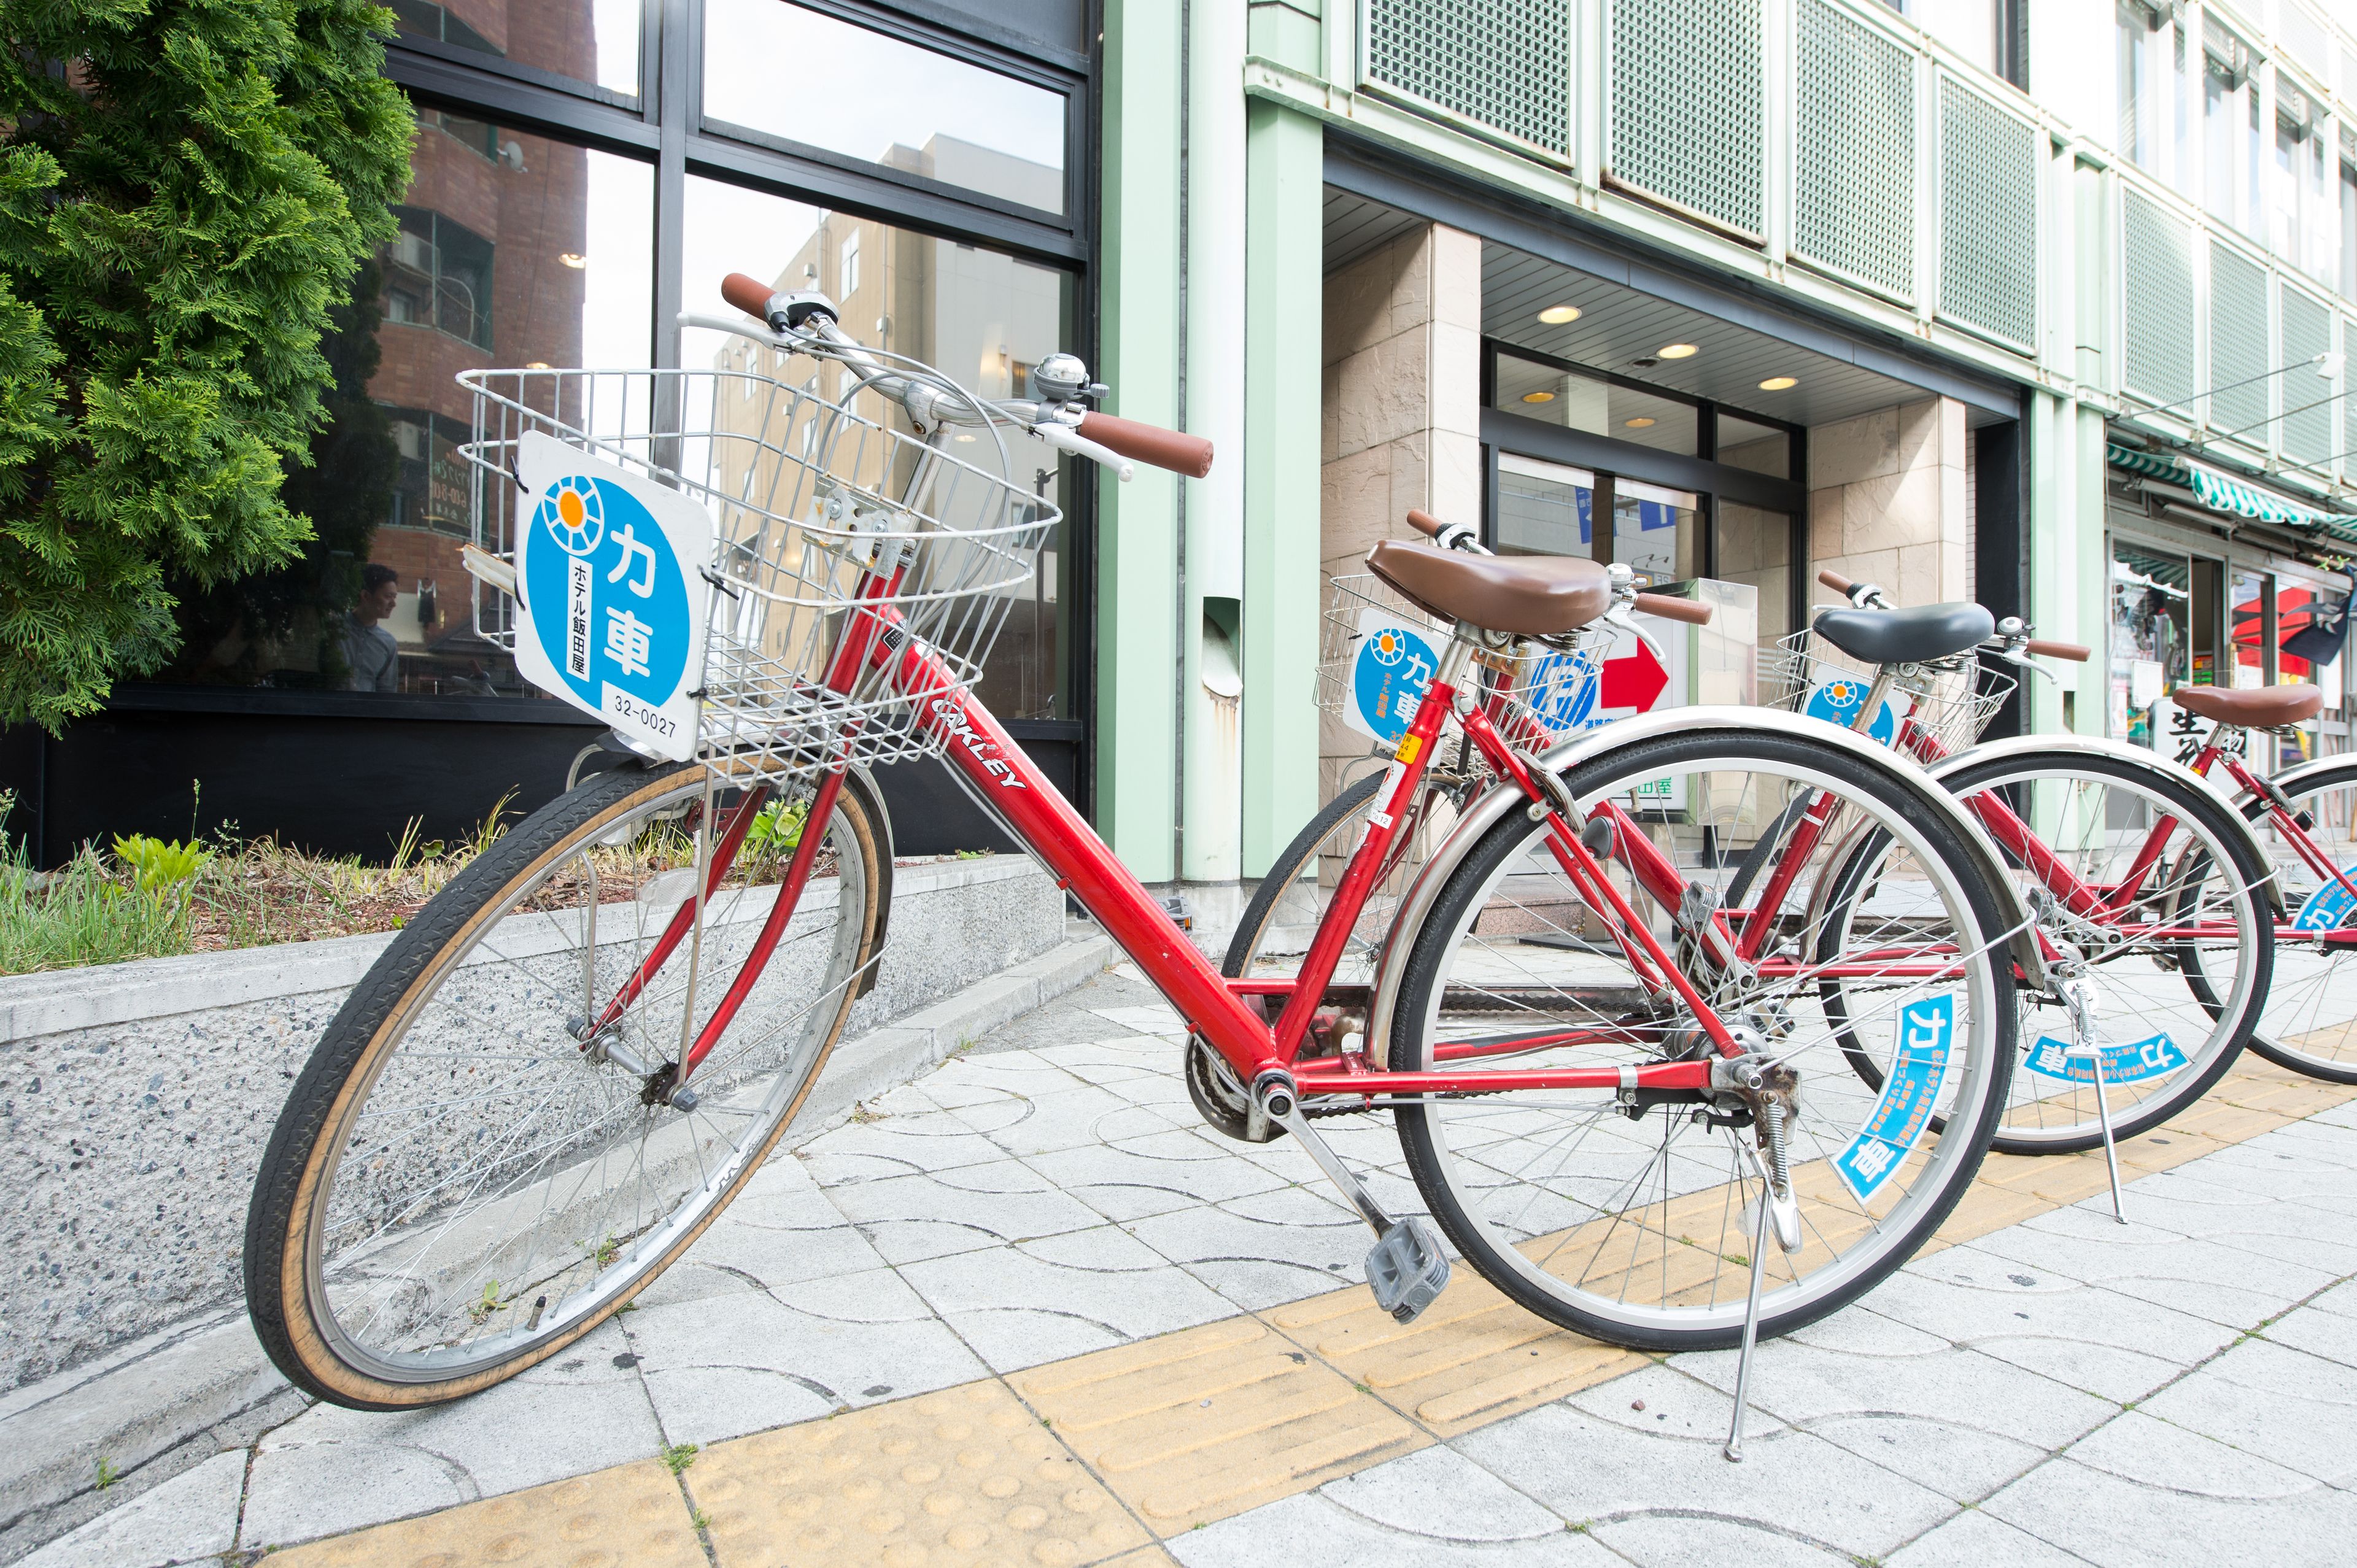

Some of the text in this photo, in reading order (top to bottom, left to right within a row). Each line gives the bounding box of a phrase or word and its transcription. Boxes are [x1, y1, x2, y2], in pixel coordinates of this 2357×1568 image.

[571, 565, 586, 675] ホテル飯田屋
[603, 523, 656, 677] 力車
[614, 695, 676, 738] 32-0027
[1585, 719, 1616, 730] 道路
[1625, 777, 1672, 794] 田屋
[1908, 1007, 1947, 1049] 力
[2035, 1044, 2068, 1074] 車
[2139, 1037, 2175, 1068] 力
[1849, 1134, 1896, 1183] 車
